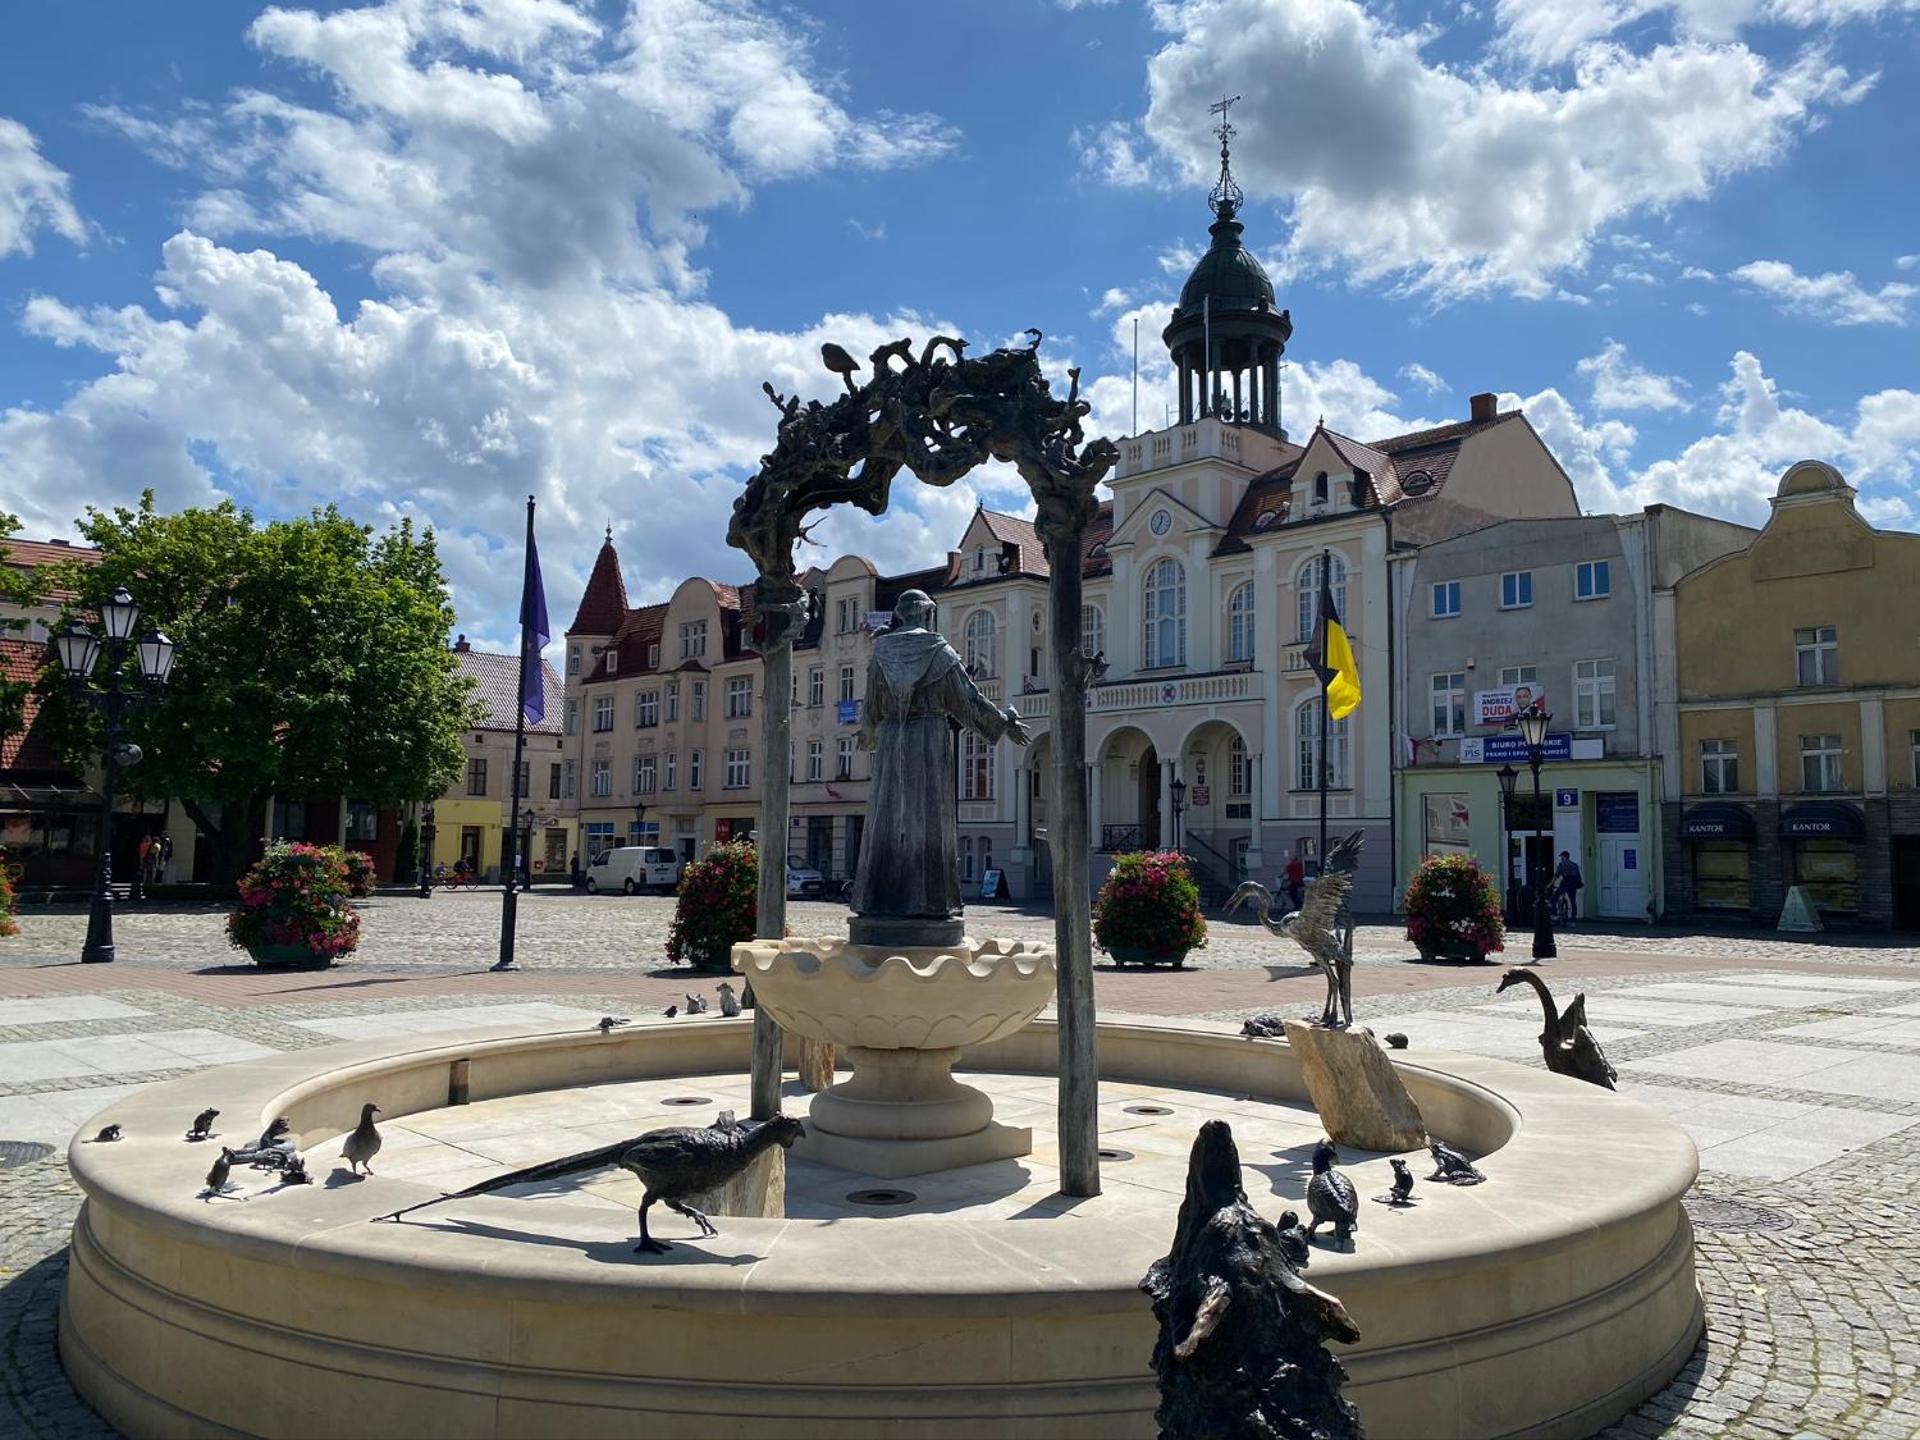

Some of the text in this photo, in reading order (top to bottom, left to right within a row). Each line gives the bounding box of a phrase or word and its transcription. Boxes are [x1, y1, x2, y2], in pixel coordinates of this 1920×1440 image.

[1481, 697, 1512, 705] ANDRZEJ
[1482, 704, 1512, 716] DUDA
[1491, 740, 1516, 749] BIURO
[1563, 794, 1572, 805] 9
[1688, 824, 1724, 833] KANTOR
[1792, 822, 1831, 831] KANTOR
